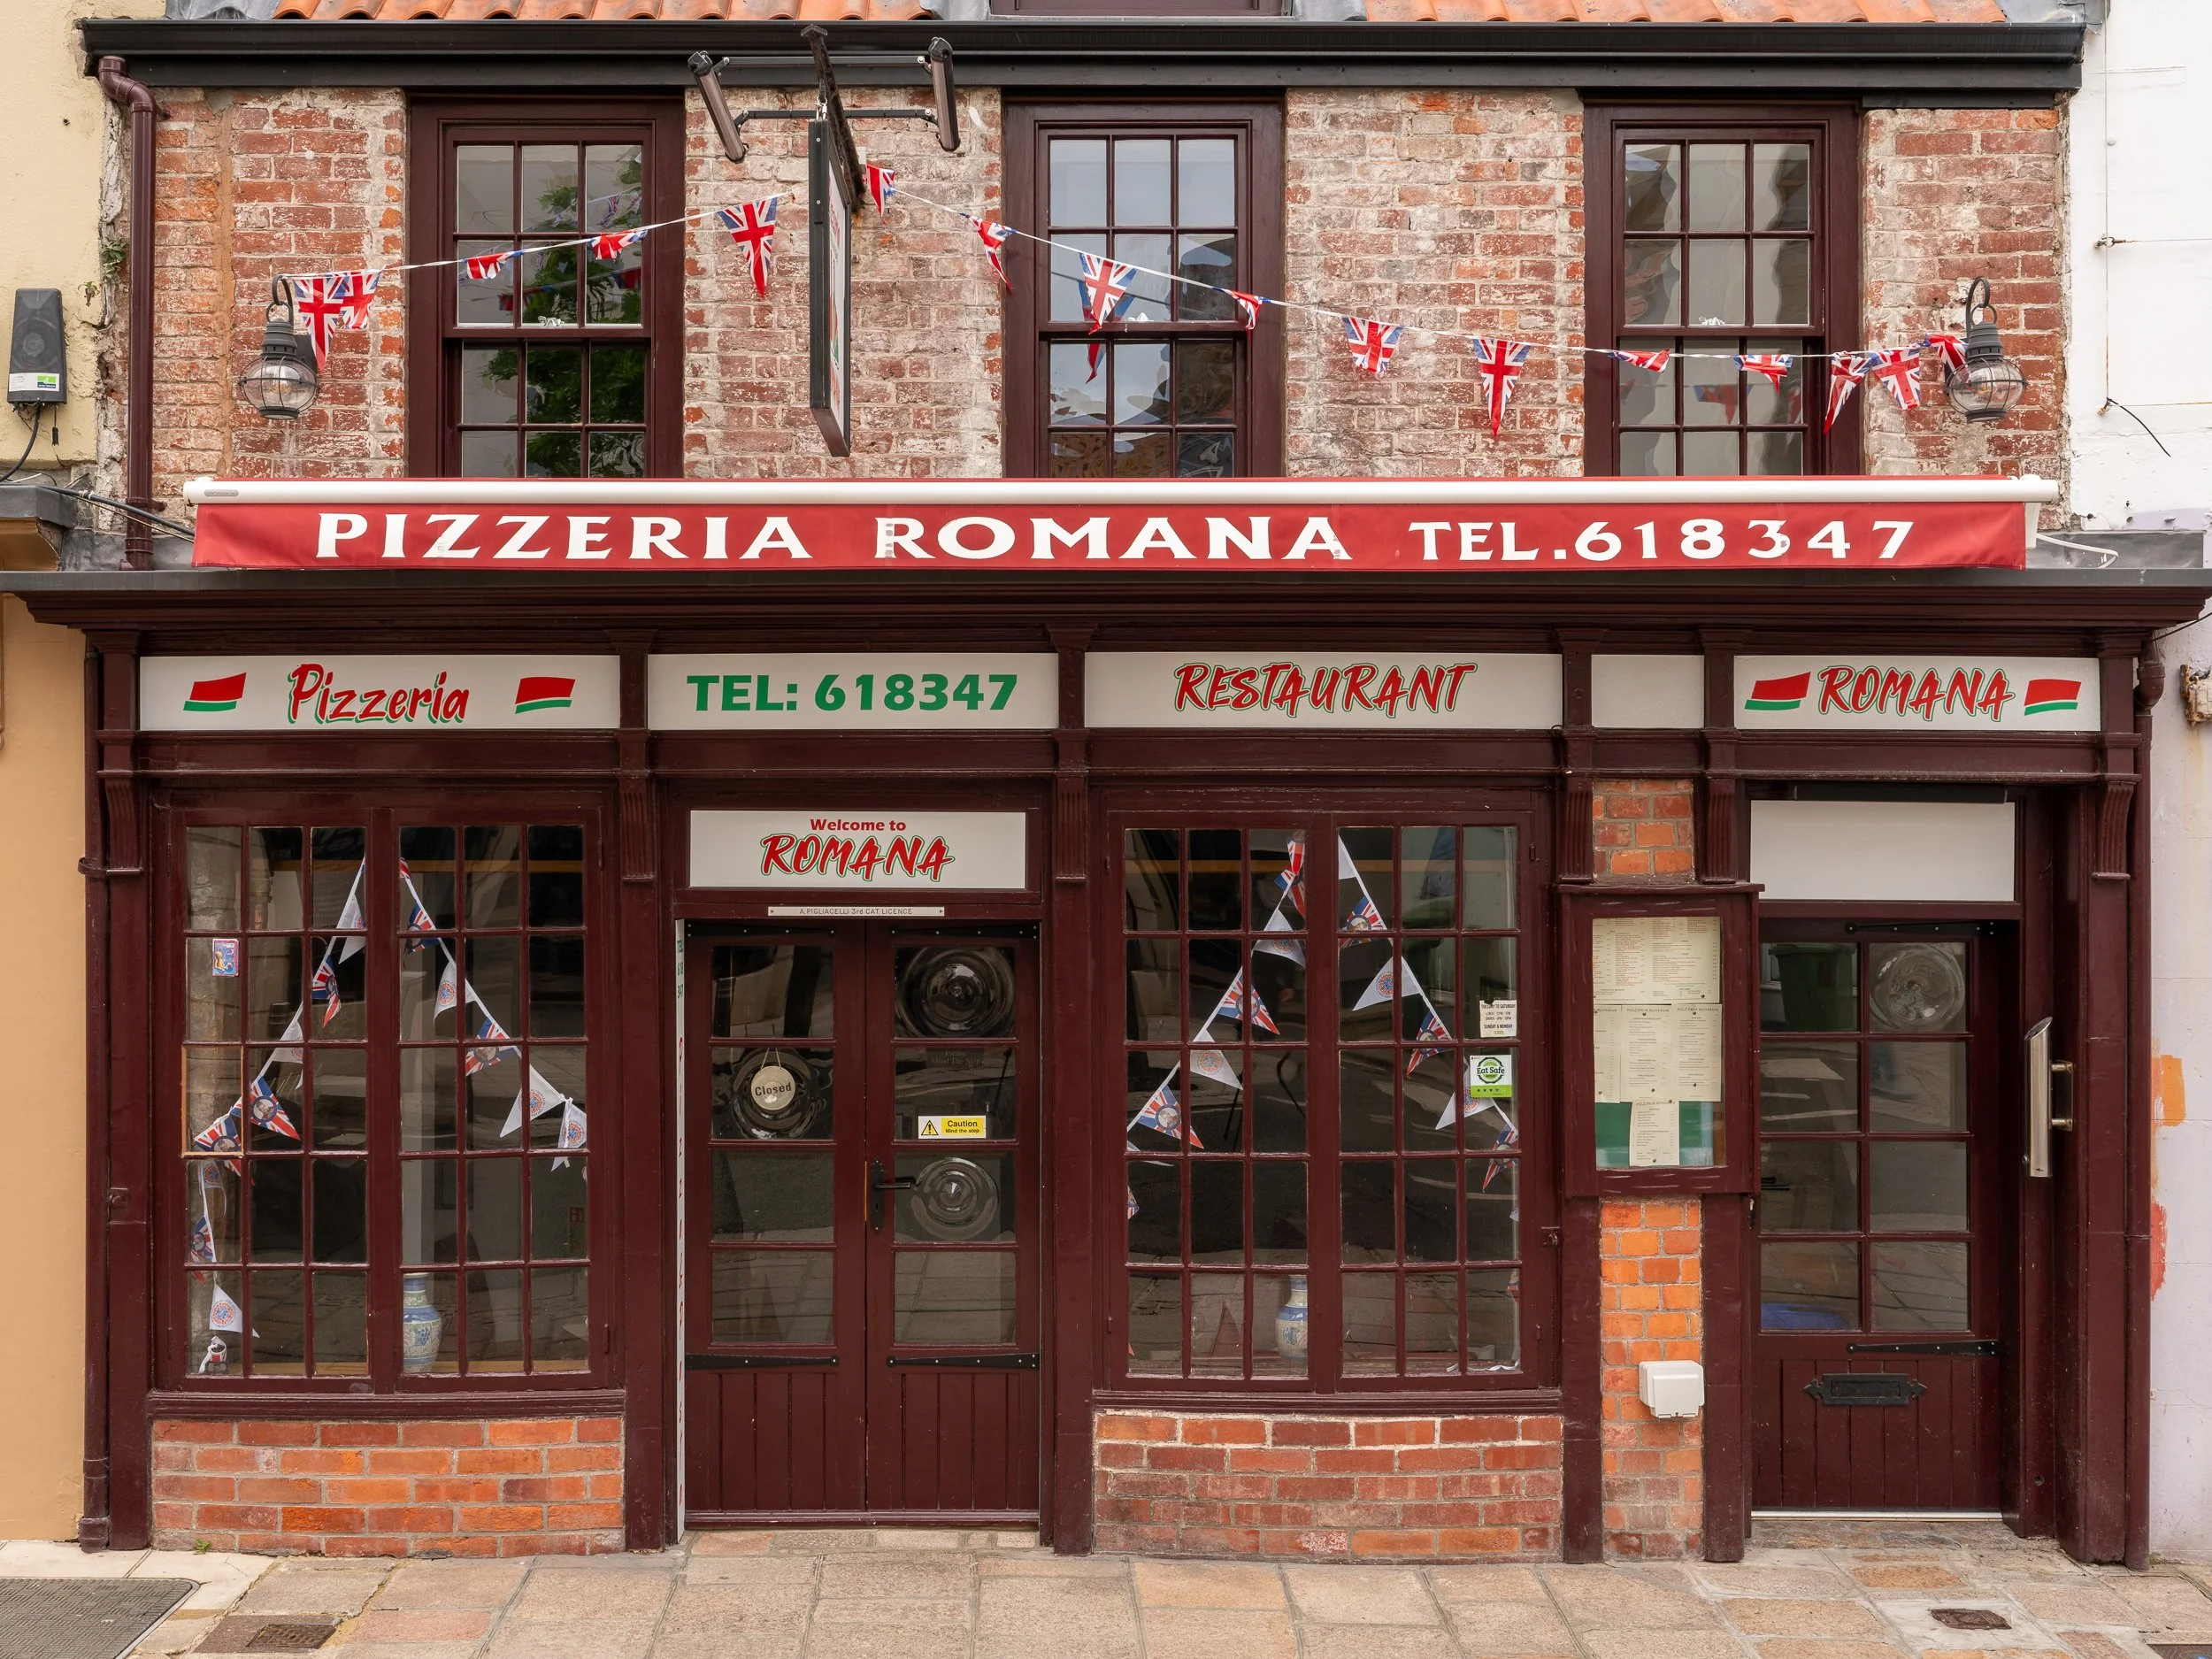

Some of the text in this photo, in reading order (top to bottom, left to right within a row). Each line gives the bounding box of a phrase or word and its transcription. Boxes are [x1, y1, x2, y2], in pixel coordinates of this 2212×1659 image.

[316, 512, 813, 560] PIZZERIA
[874, 516, 1354, 561] ROMANA
[287, 663, 470, 725] Pizzeria
[687, 673, 1018, 711] TEL: 618347
[1174, 662, 1479, 718] RESTAURANT
[1817, 665, 2016, 722] ROMANA
[810, 818, 907, 831] Welcome to
[760, 833, 956, 882] ROMANA
[755, 1081, 792, 1096] Closed
